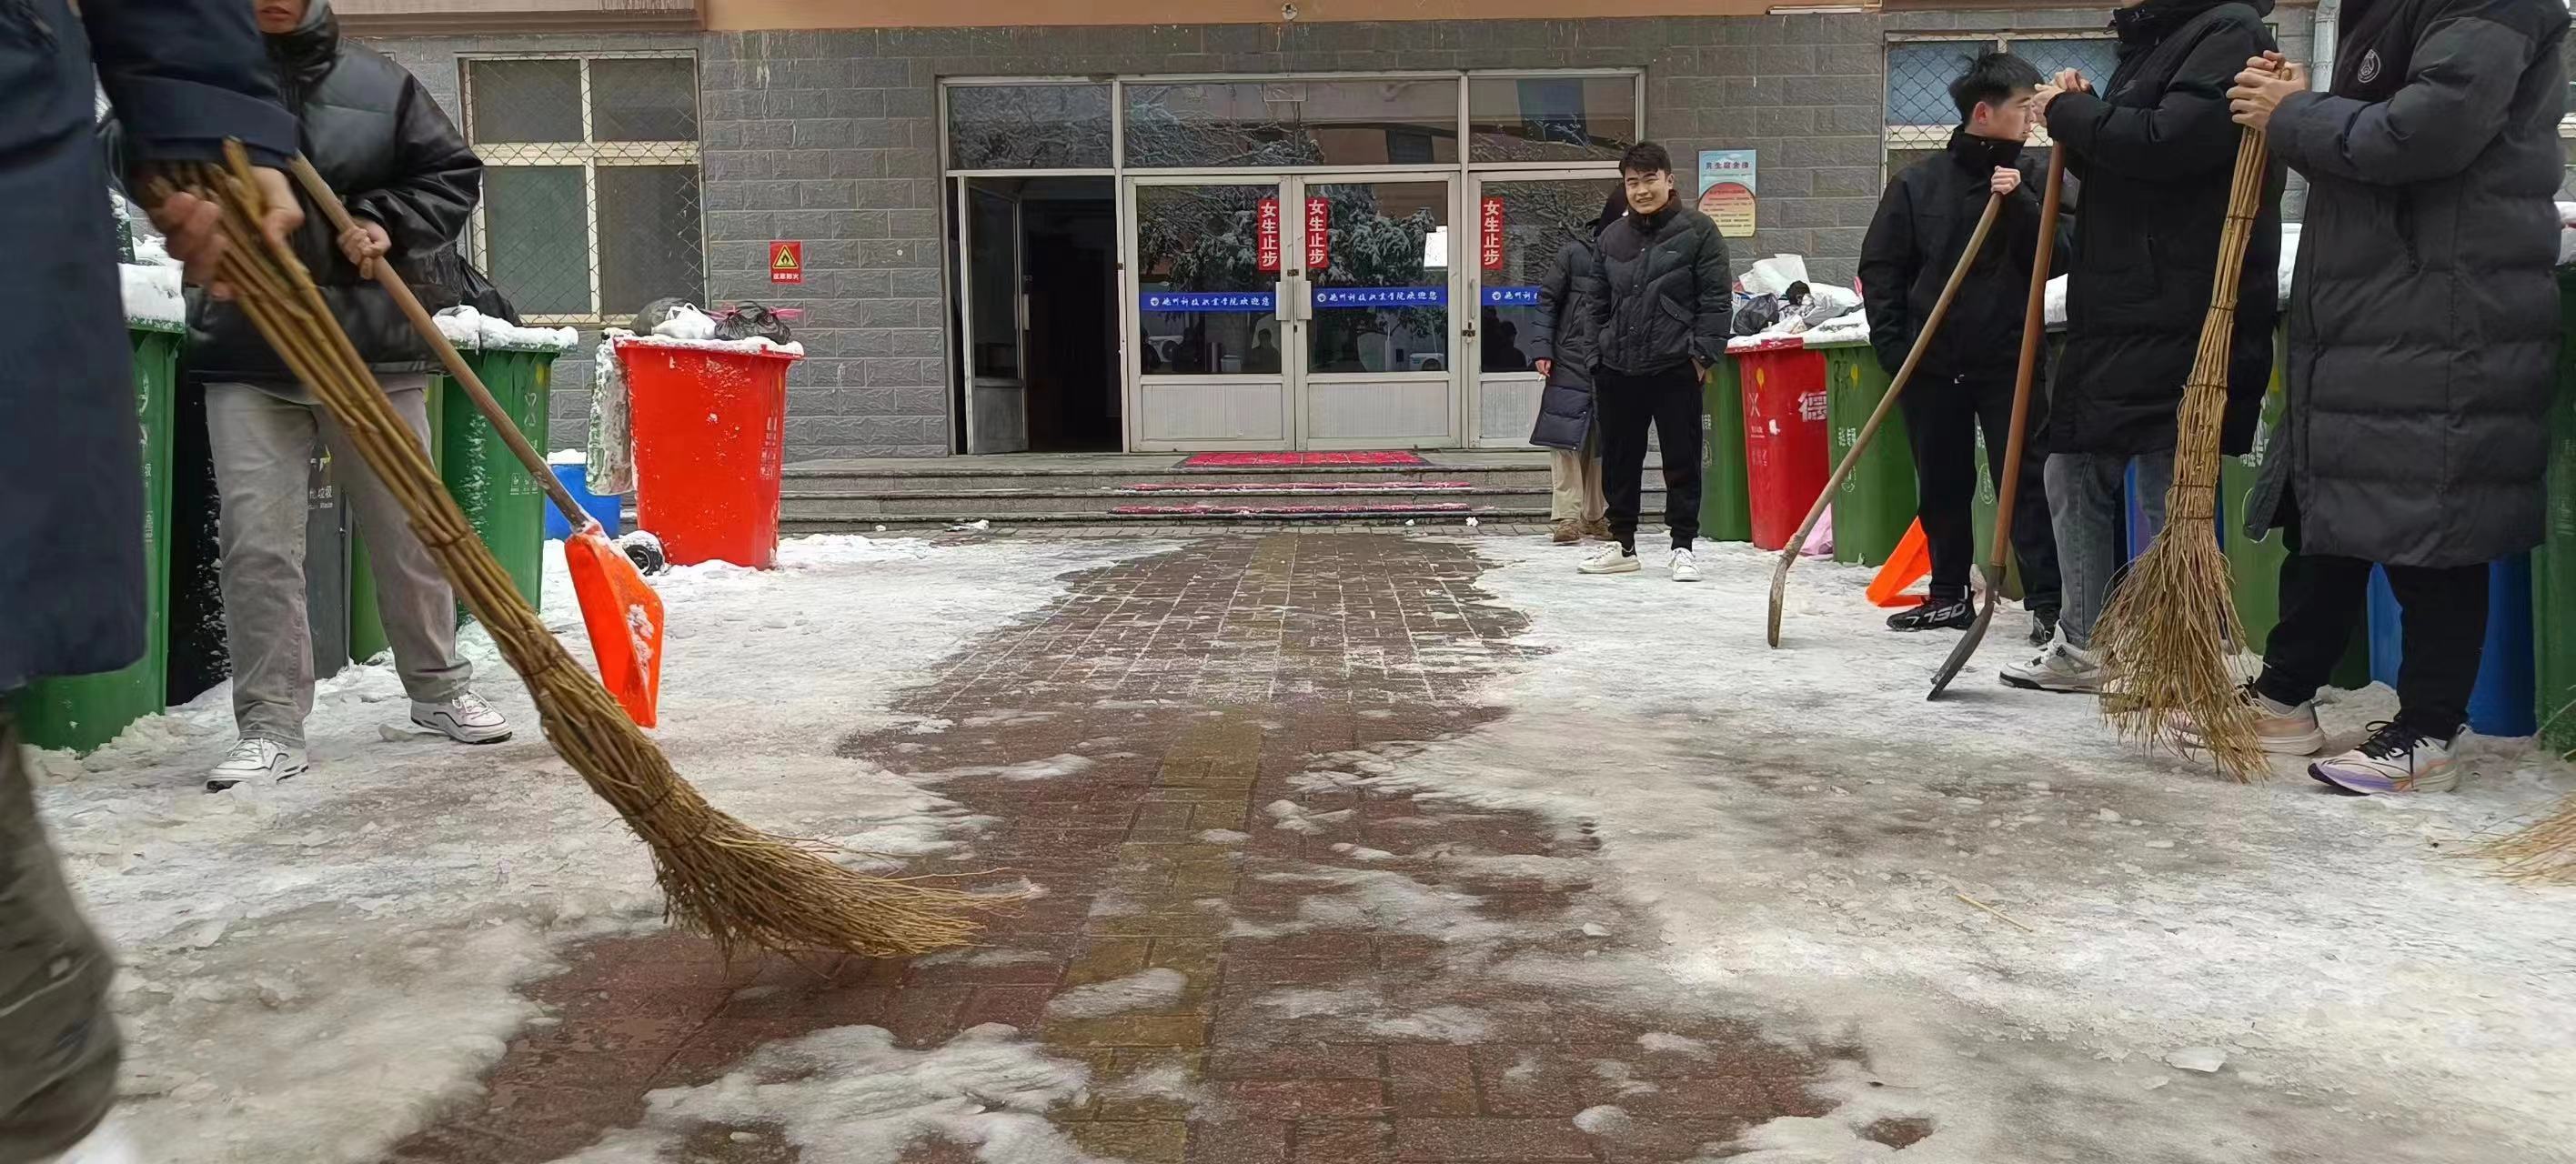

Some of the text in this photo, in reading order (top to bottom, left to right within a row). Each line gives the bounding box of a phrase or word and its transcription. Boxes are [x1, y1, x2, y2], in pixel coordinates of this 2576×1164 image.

[1261, 202, 1278, 267] 女生止步
[1308, 199, 1325, 265] 女生止步
[1484, 200, 1500, 266] 女生止步
